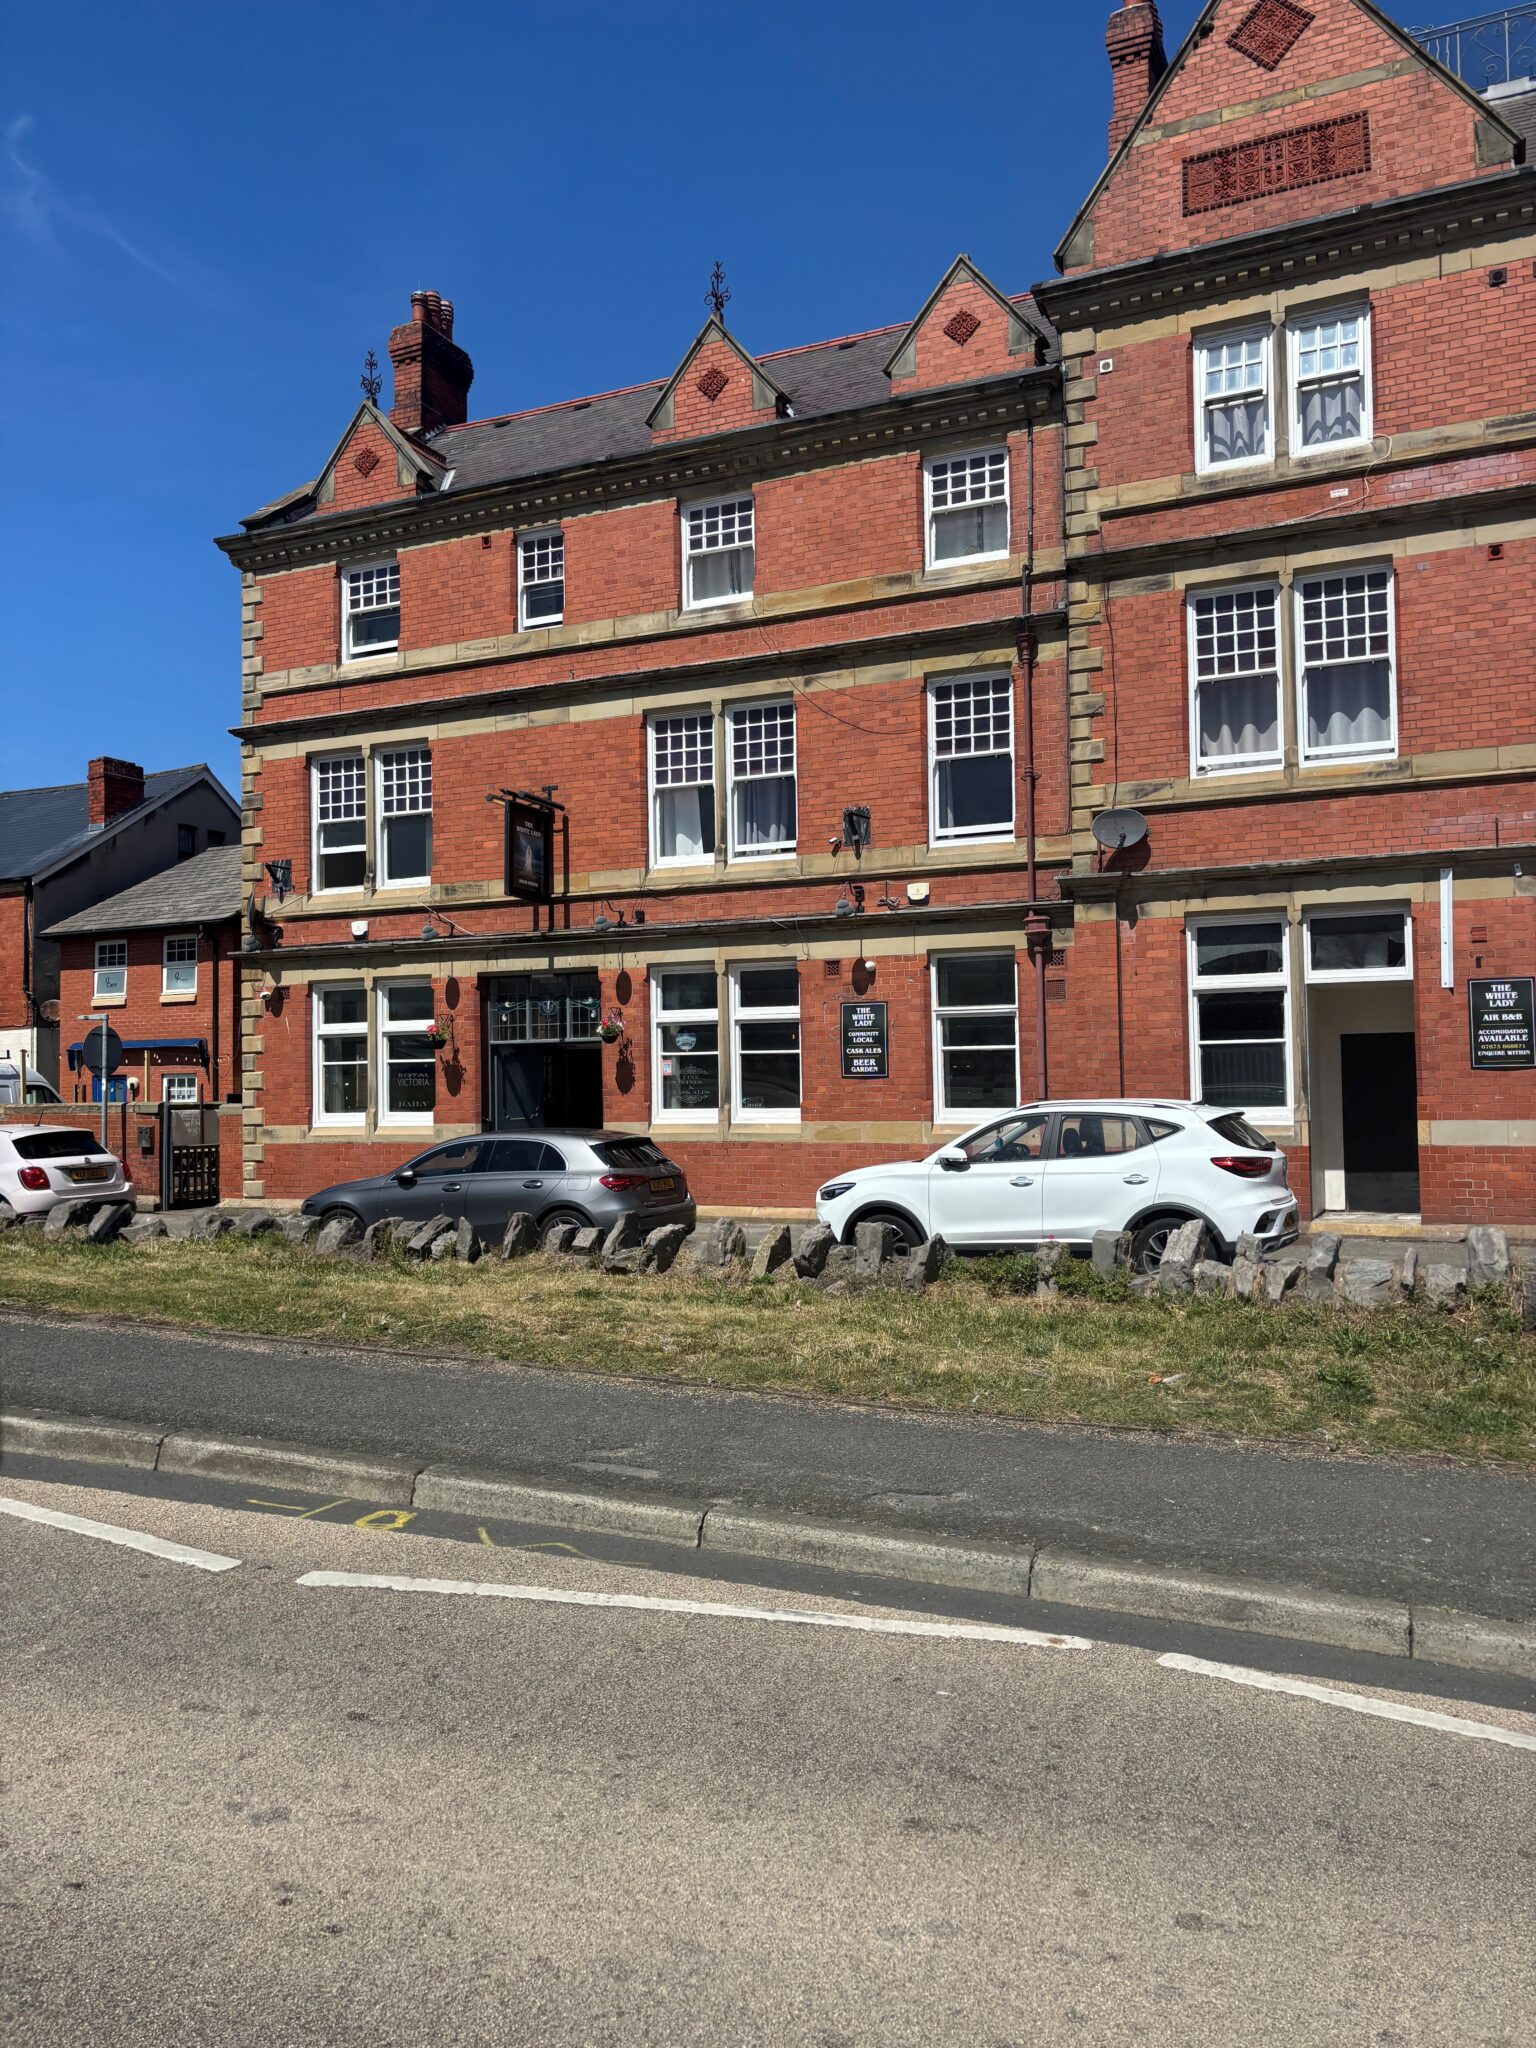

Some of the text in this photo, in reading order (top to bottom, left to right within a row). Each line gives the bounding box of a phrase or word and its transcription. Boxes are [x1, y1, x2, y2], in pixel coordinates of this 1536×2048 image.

[1485, 992, 1518, 1000] WHITE
[1478, 1034, 1528, 1042] AVAILABLE
[397, 1078, 430, 1087] VICTORIA
